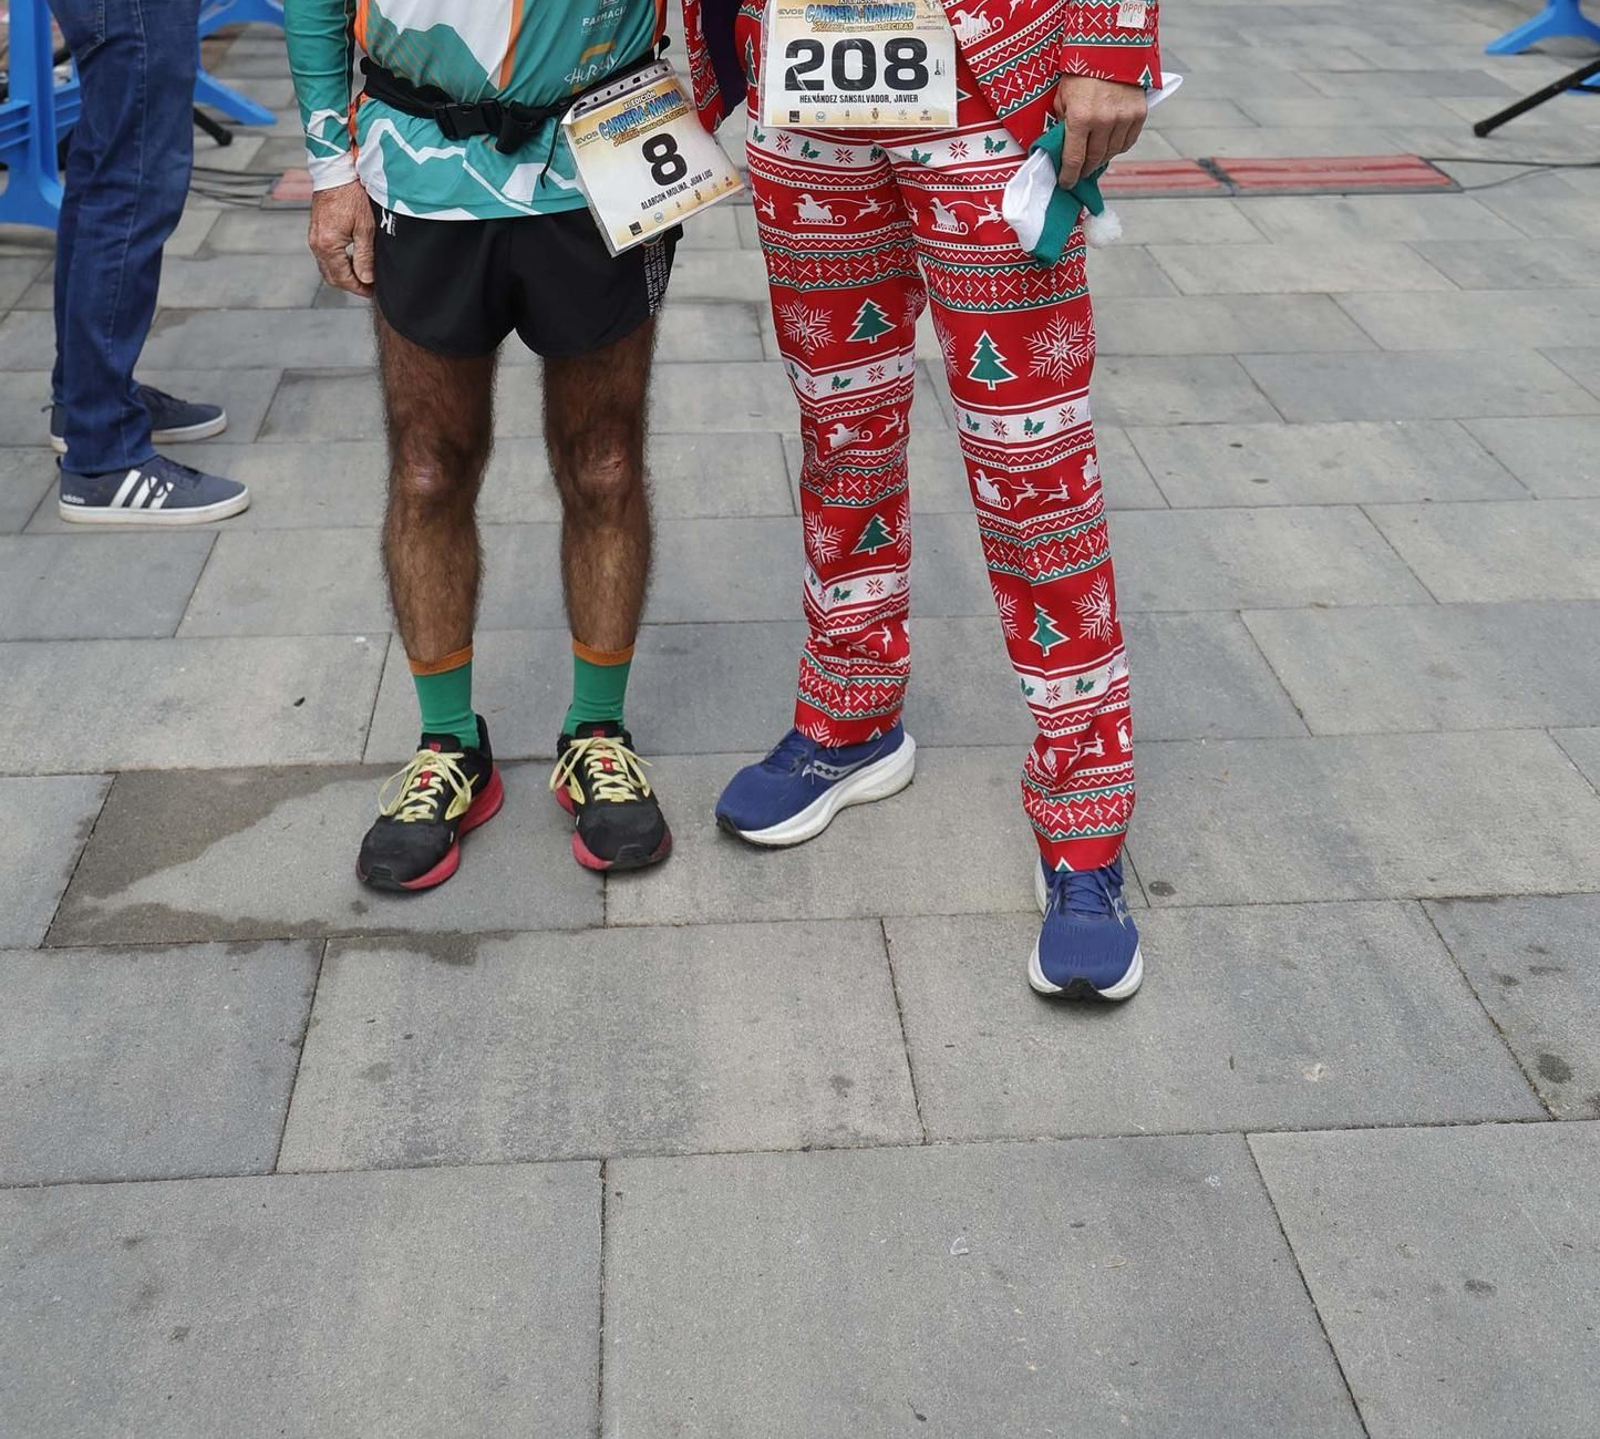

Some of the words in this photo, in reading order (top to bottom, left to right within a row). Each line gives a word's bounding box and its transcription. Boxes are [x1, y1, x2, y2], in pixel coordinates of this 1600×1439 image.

[805, 4, 861, 24] CARRERA
[864, 2, 916, 23] NAVIDAD
[785, 37, 929, 91] 208
[839, 94, 892, 105] SANSALVADOR,
[894, 94, 919, 103] JAVIER
[598, 104, 649, 140] CARRERA
[642, 133, 688, 186] 8
